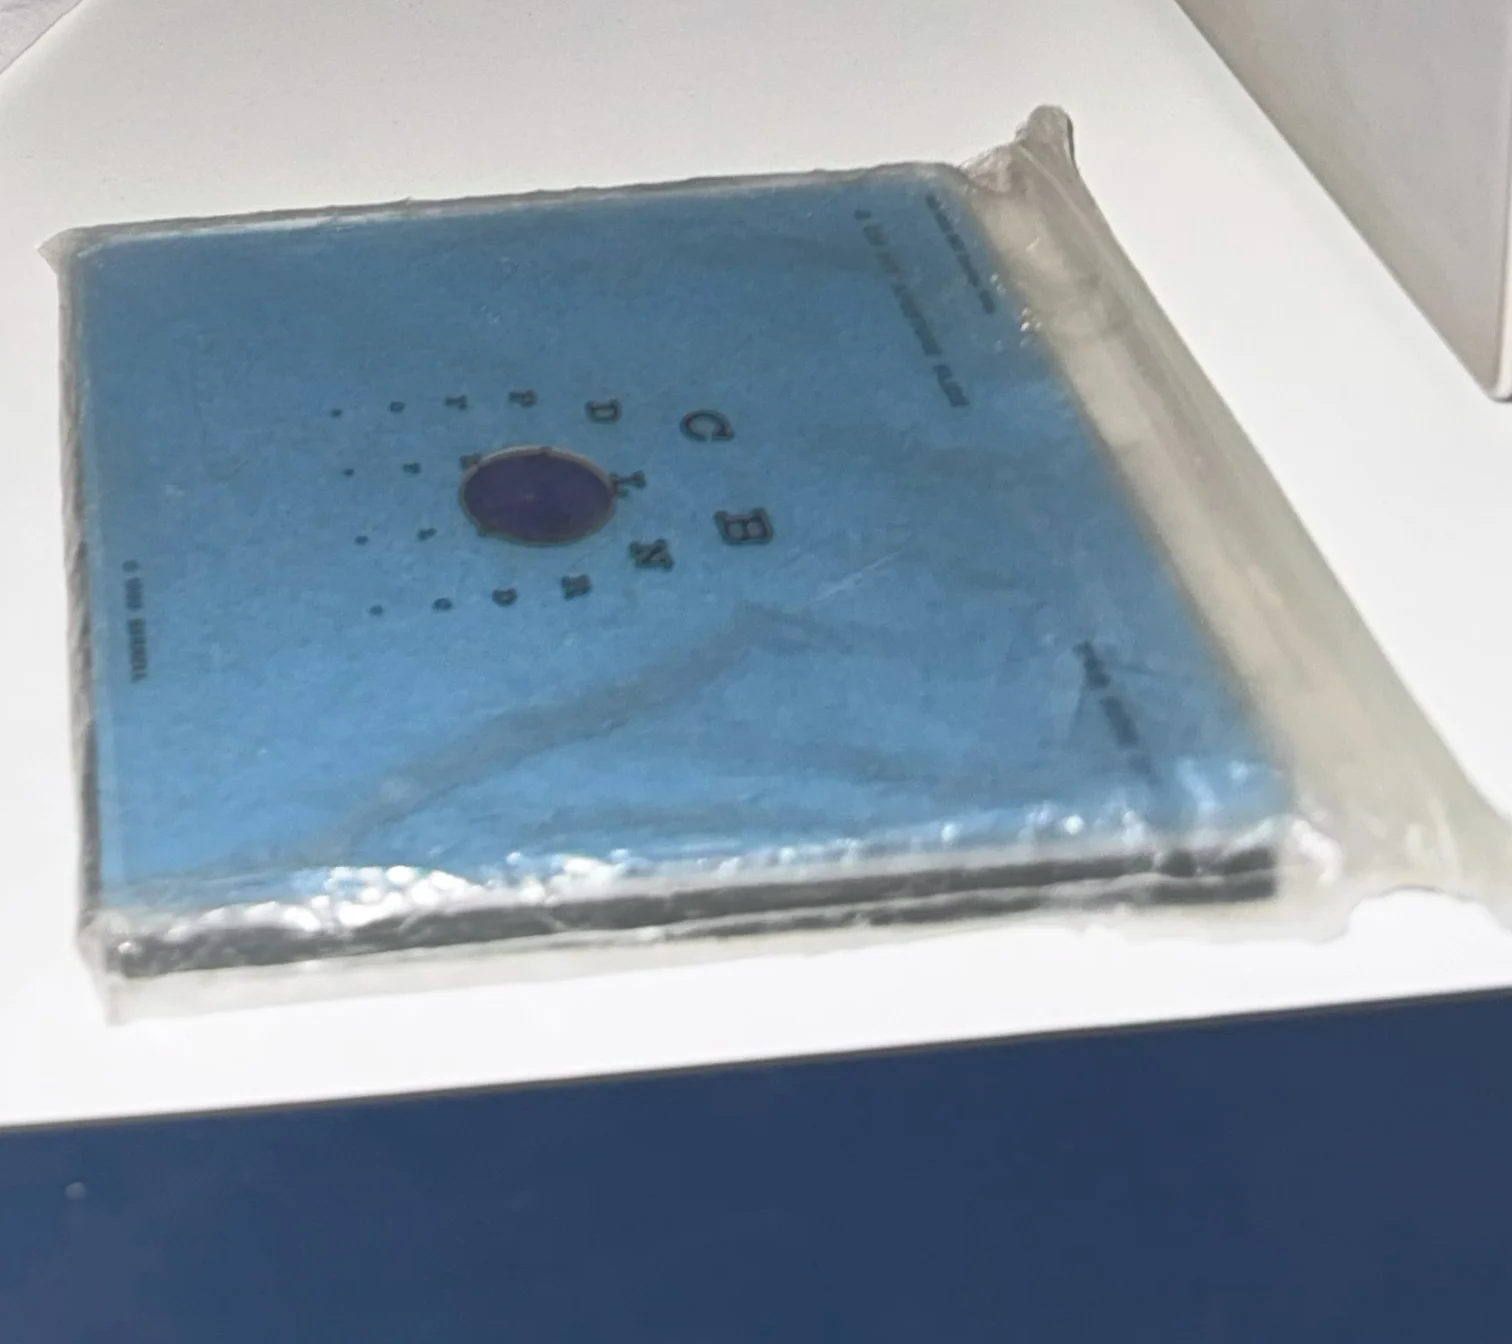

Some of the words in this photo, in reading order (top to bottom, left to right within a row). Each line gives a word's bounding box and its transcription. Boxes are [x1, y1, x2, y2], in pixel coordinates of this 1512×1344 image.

[585, 400, 621, 424] D
[680, 411, 734, 442] C
[714, 508, 774, 546] B
